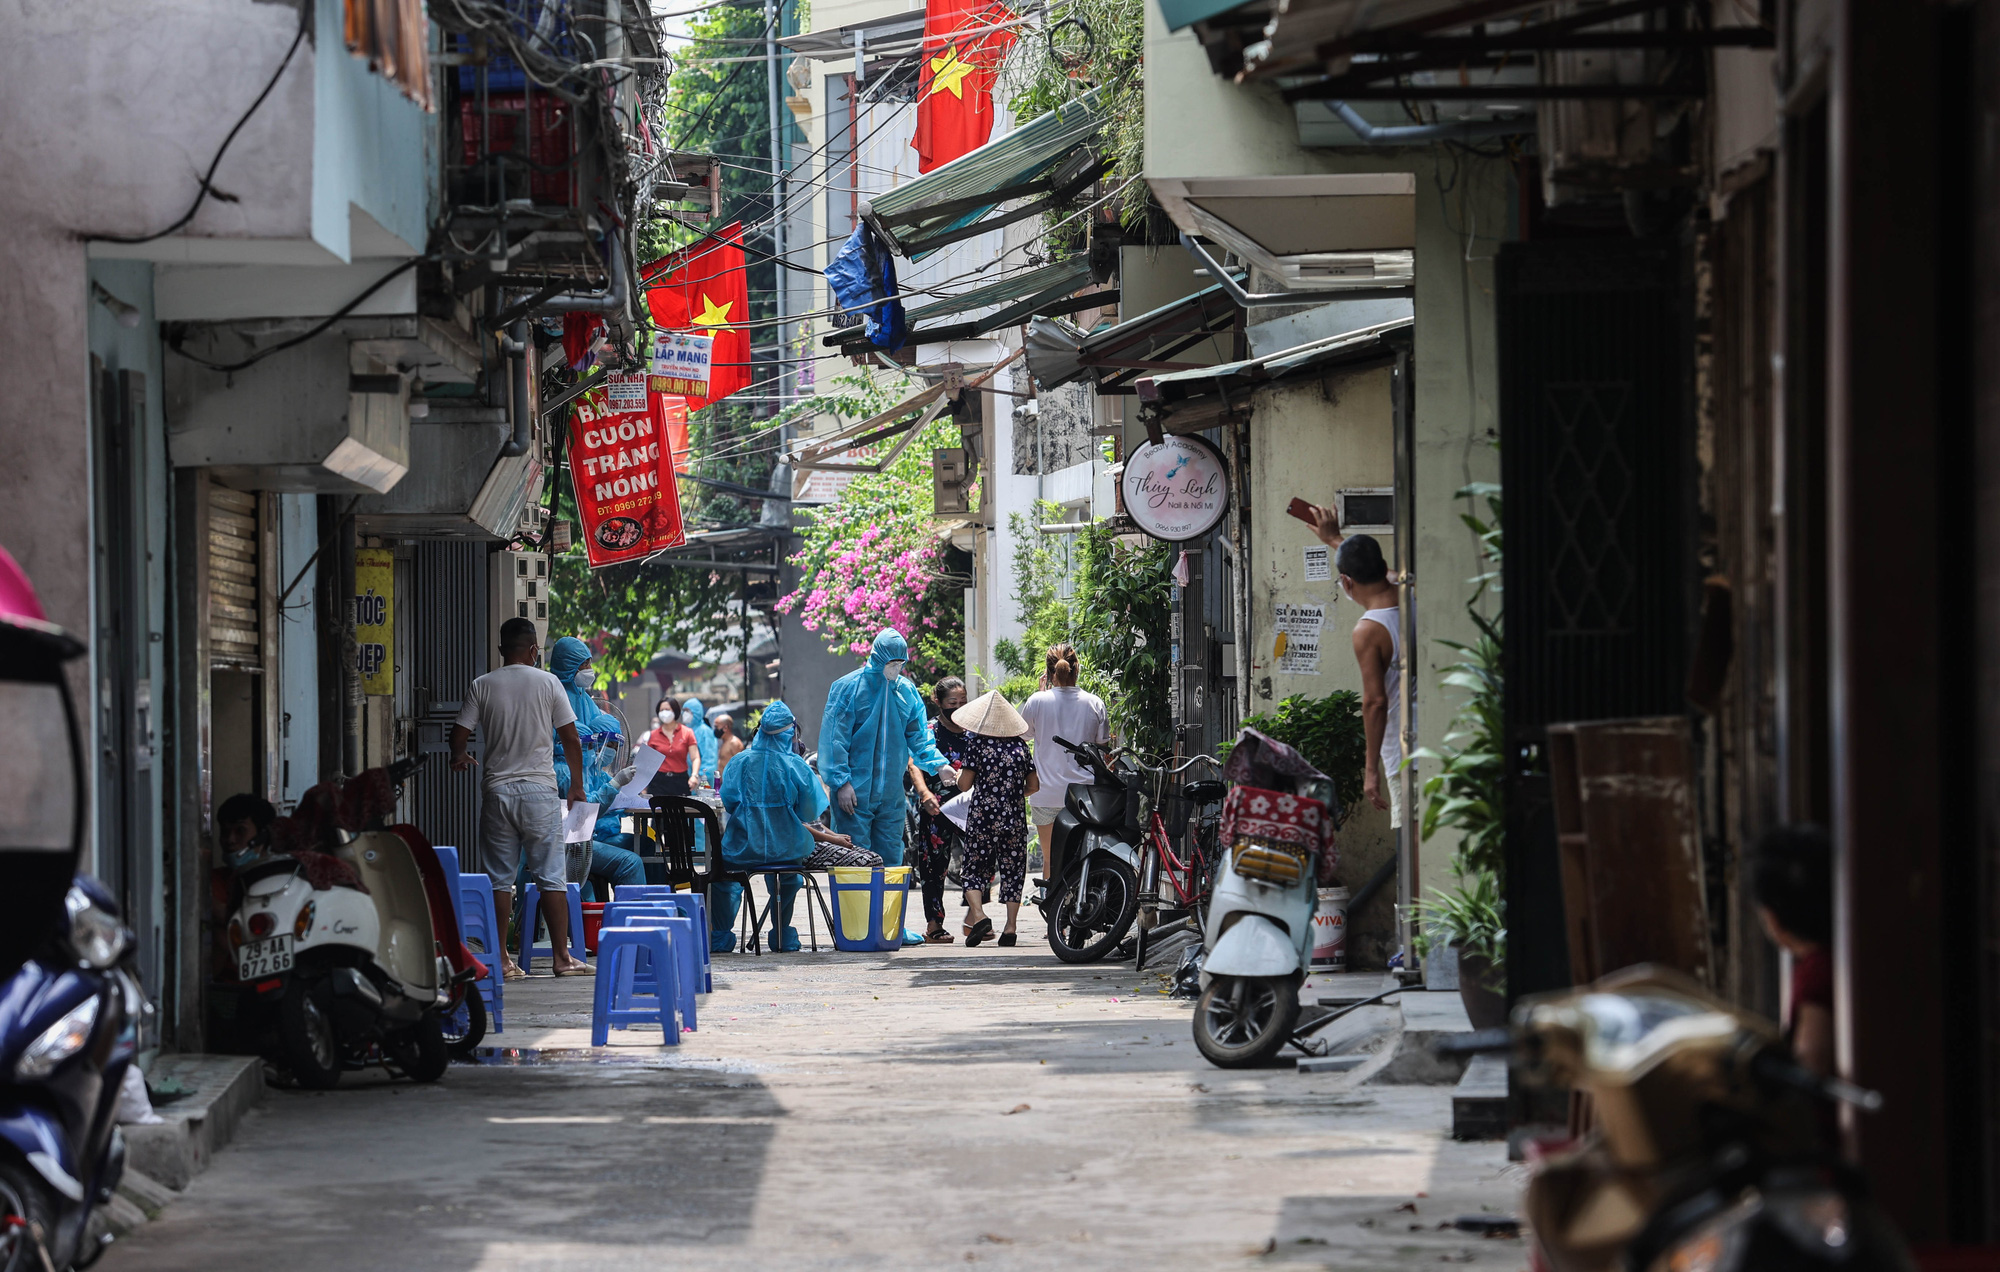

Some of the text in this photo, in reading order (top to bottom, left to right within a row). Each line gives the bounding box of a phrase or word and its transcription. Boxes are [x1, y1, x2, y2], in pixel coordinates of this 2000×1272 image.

[655, 344, 708, 365] LẮP MẠNG
[608, 371, 625, 384] SỬA
[584, 415, 654, 449] CUỐN
[582, 442, 660, 476] TRÁNG
[1144, 441, 1208, 460] Beauty Academy
[595, 470, 659, 502] NÓNG
[1180, 472, 1218, 499] Linh
[597, 506, 613, 516] ĐT:
[614, 500, 636, 512] 0969
[356, 588, 386, 626] TÓC
[1314, 915, 1343, 927] VIVA
[246, 937, 285, 960] 29-AA
[241, 953, 290, 978] 872.66
